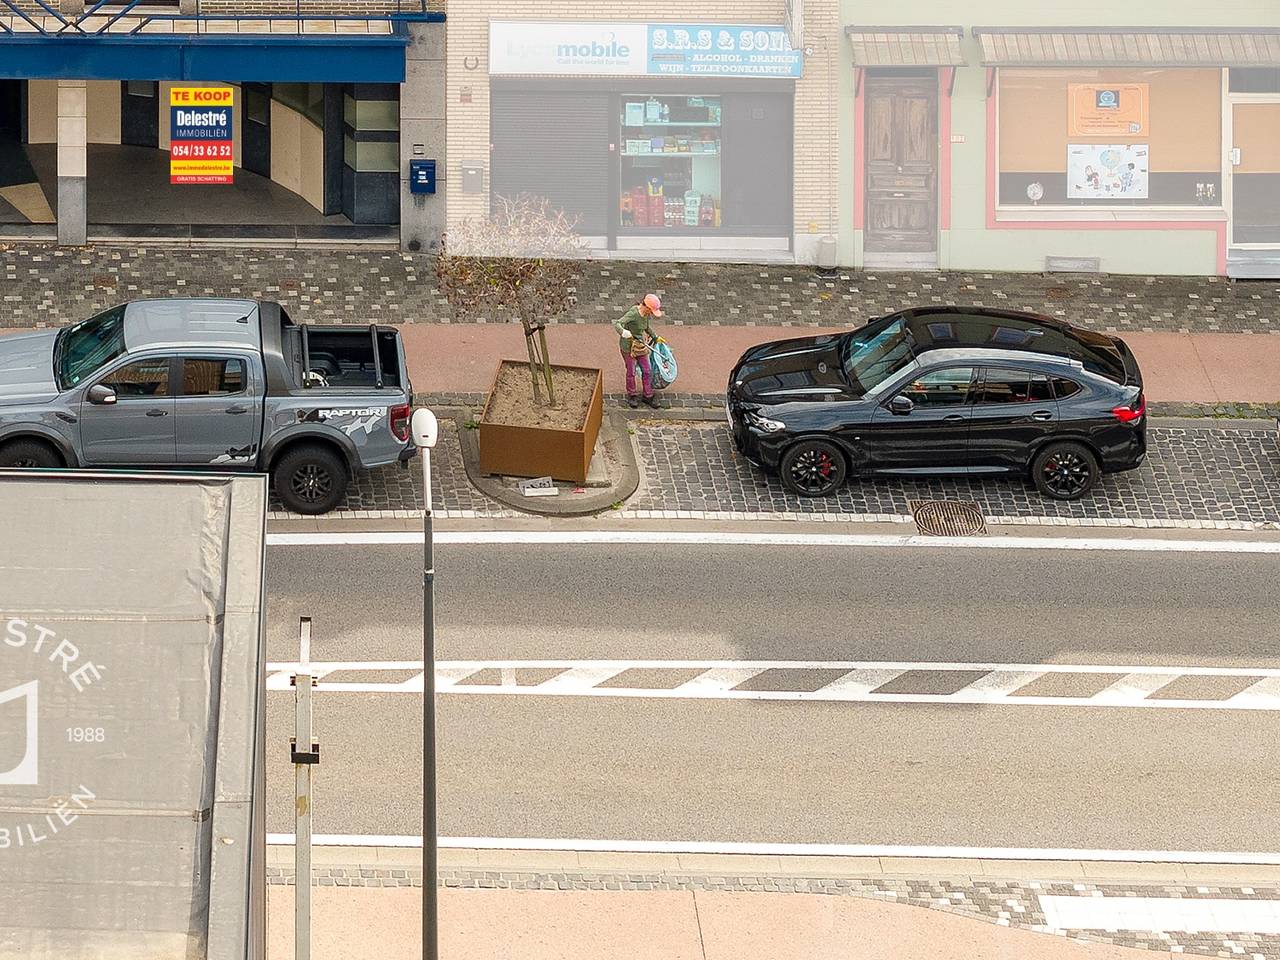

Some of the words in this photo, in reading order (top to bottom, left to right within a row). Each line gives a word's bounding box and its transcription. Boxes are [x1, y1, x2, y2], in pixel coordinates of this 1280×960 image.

[693, 54, 742, 63] ALCOHOL
[750, 54, 799, 63] DRANKEN
[659, 64, 684, 72] WIJN
[691, 64, 792, 73] TELEFOONKAARTEN
[173, 92, 189, 101] TE
[194, 92, 230, 101] KOOP
[177, 110, 226, 126] Delestré
[173, 145, 204, 156] 054/33
[207, 146, 217, 155] 62
[220, 146, 231, 155] 52
[319, 408, 382, 419] RAPTOR
